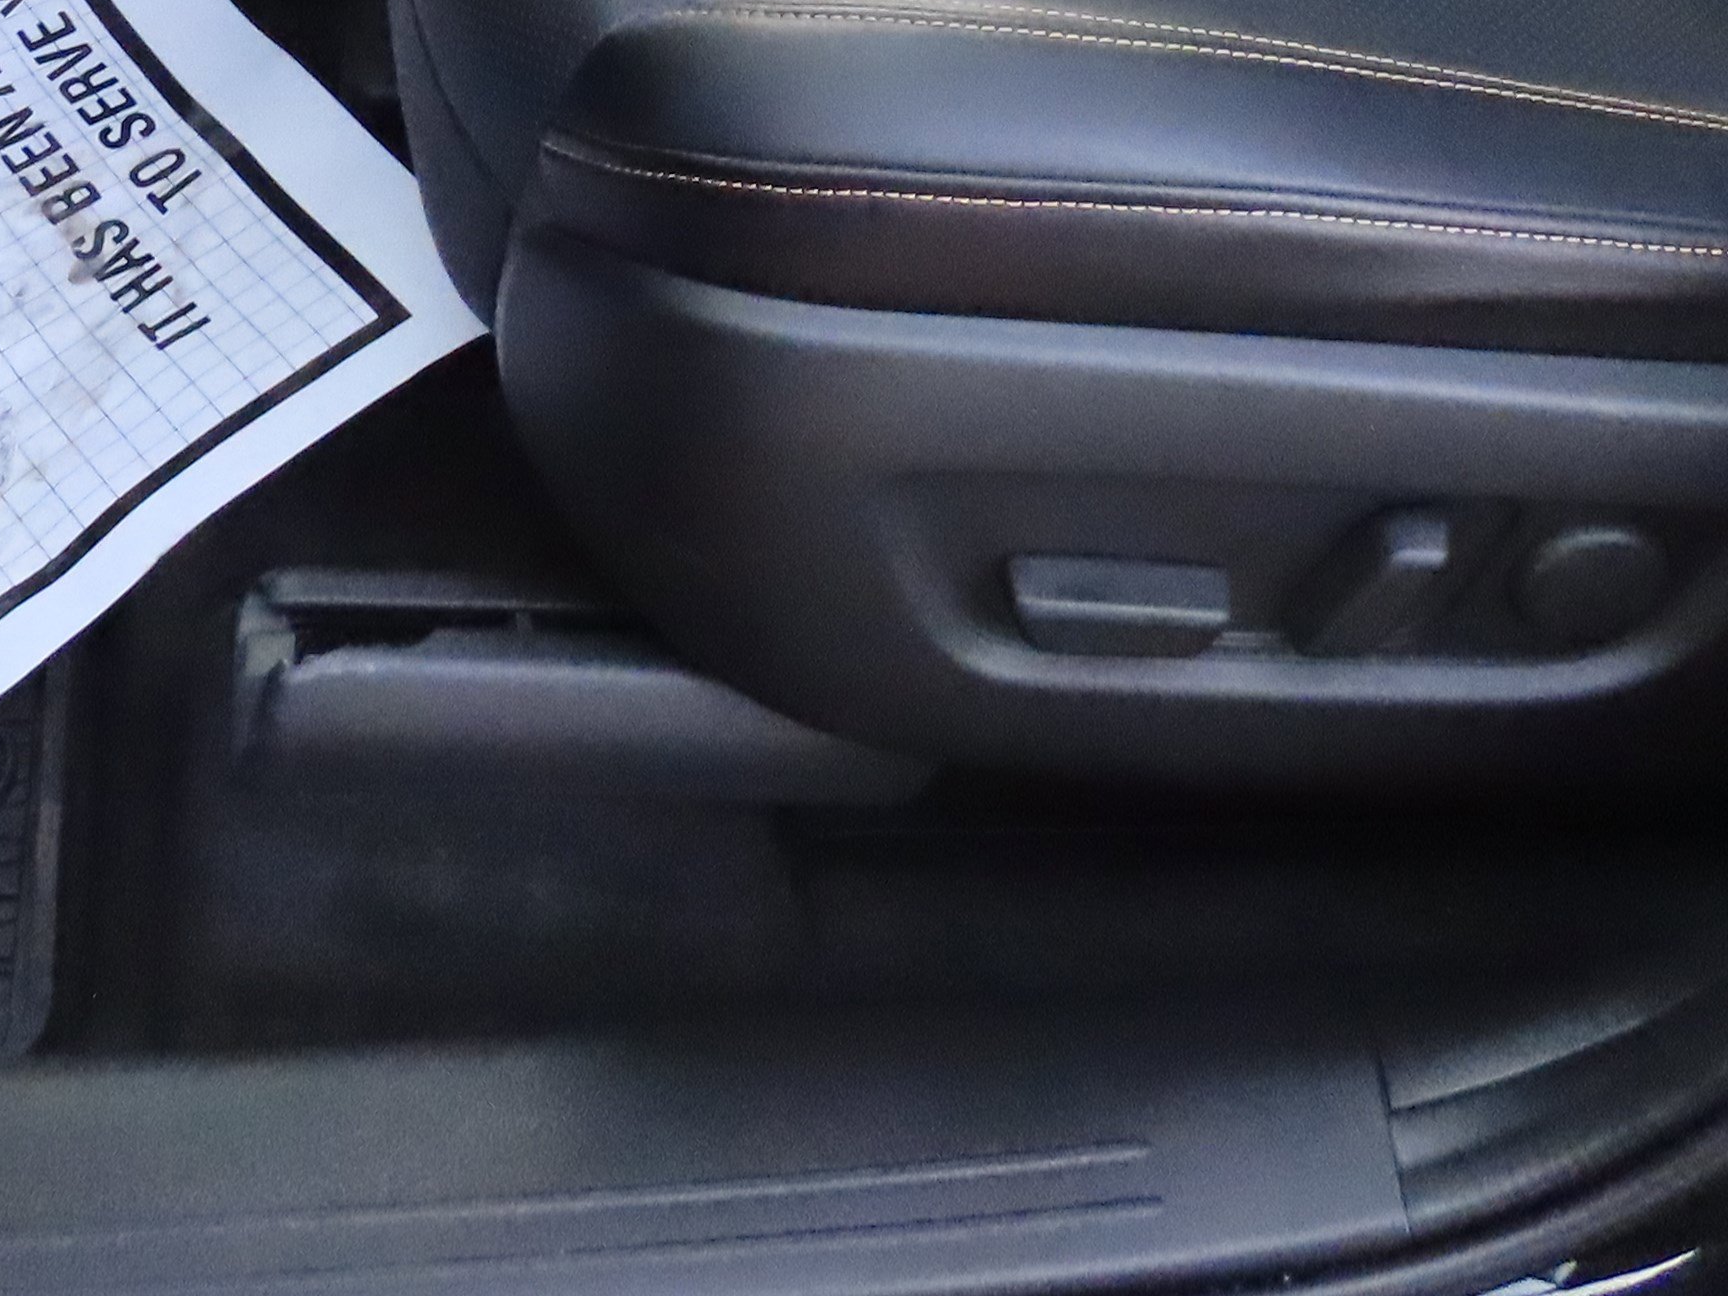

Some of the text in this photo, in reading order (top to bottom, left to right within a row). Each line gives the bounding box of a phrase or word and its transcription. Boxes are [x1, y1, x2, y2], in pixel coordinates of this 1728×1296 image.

[17, 12, 155, 148] SERVE
[129, 149, 201, 213] TO
[74, 220, 171, 312] HAS
[137, 302, 209, 349] IT
